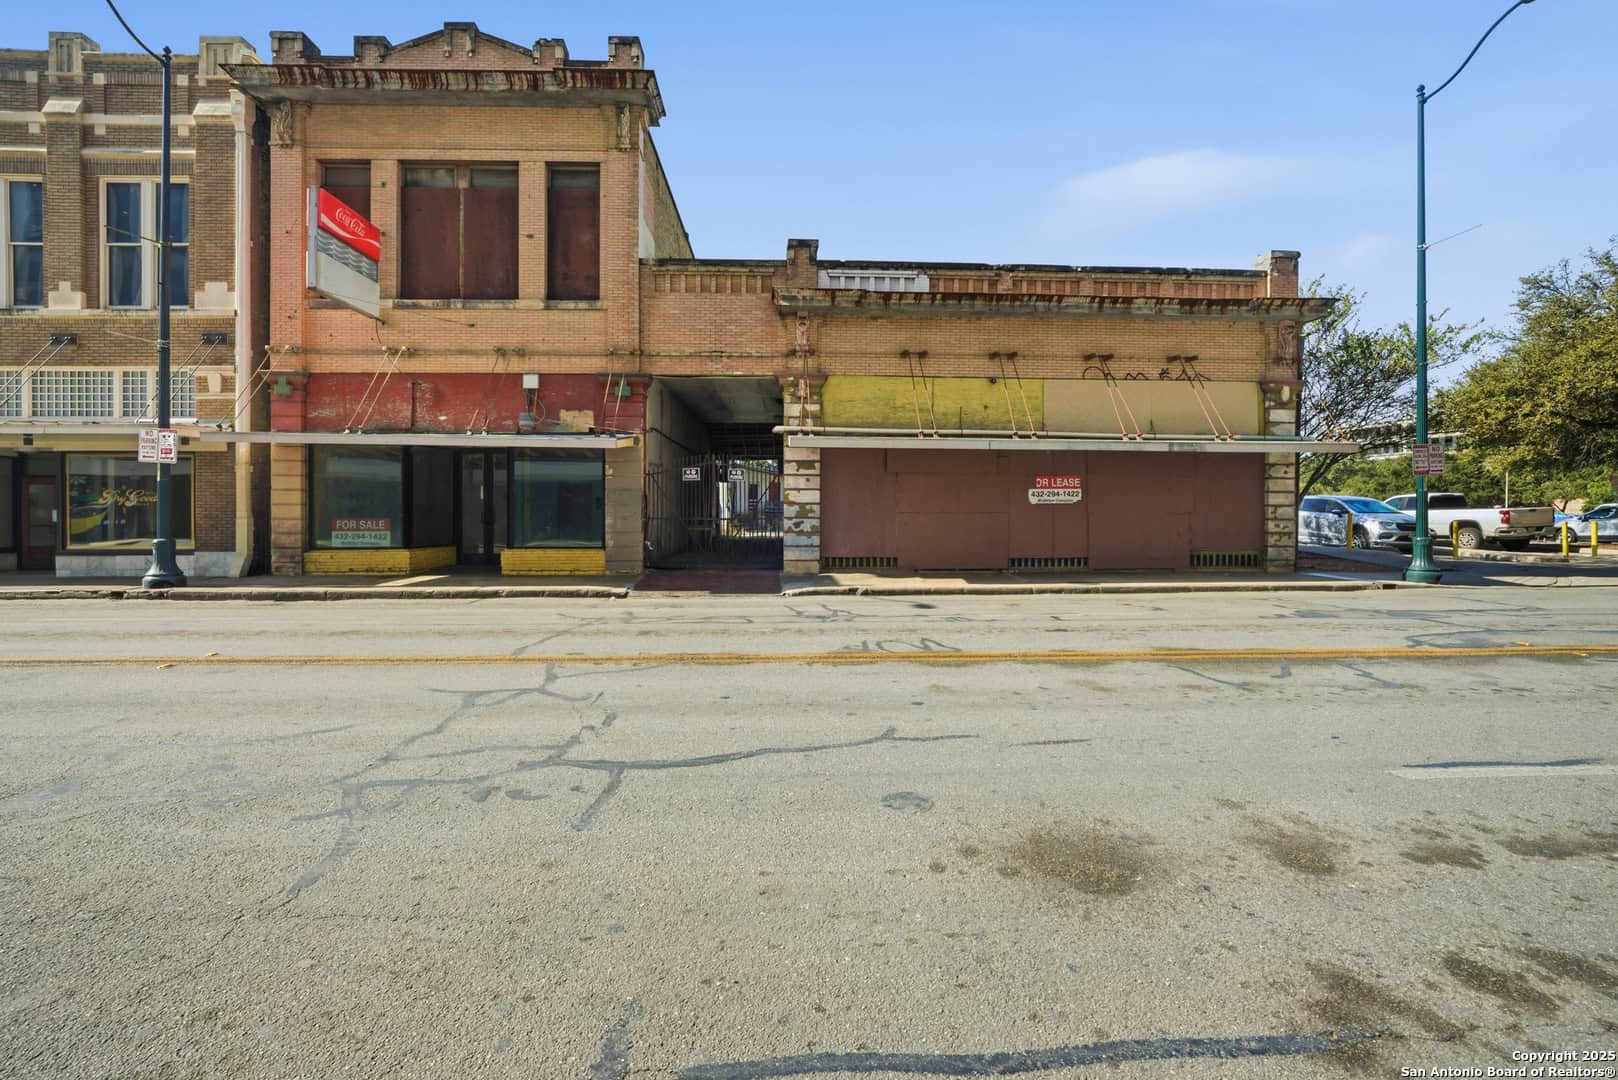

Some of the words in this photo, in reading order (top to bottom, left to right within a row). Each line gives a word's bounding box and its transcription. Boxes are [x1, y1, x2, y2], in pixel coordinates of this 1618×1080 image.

[1051, 478, 1081, 488] LEASE
[1030, 490, 1080, 498] 432-294-1422
[336, 519, 357, 530] FOR
[359, 519, 385, 530] SALE
